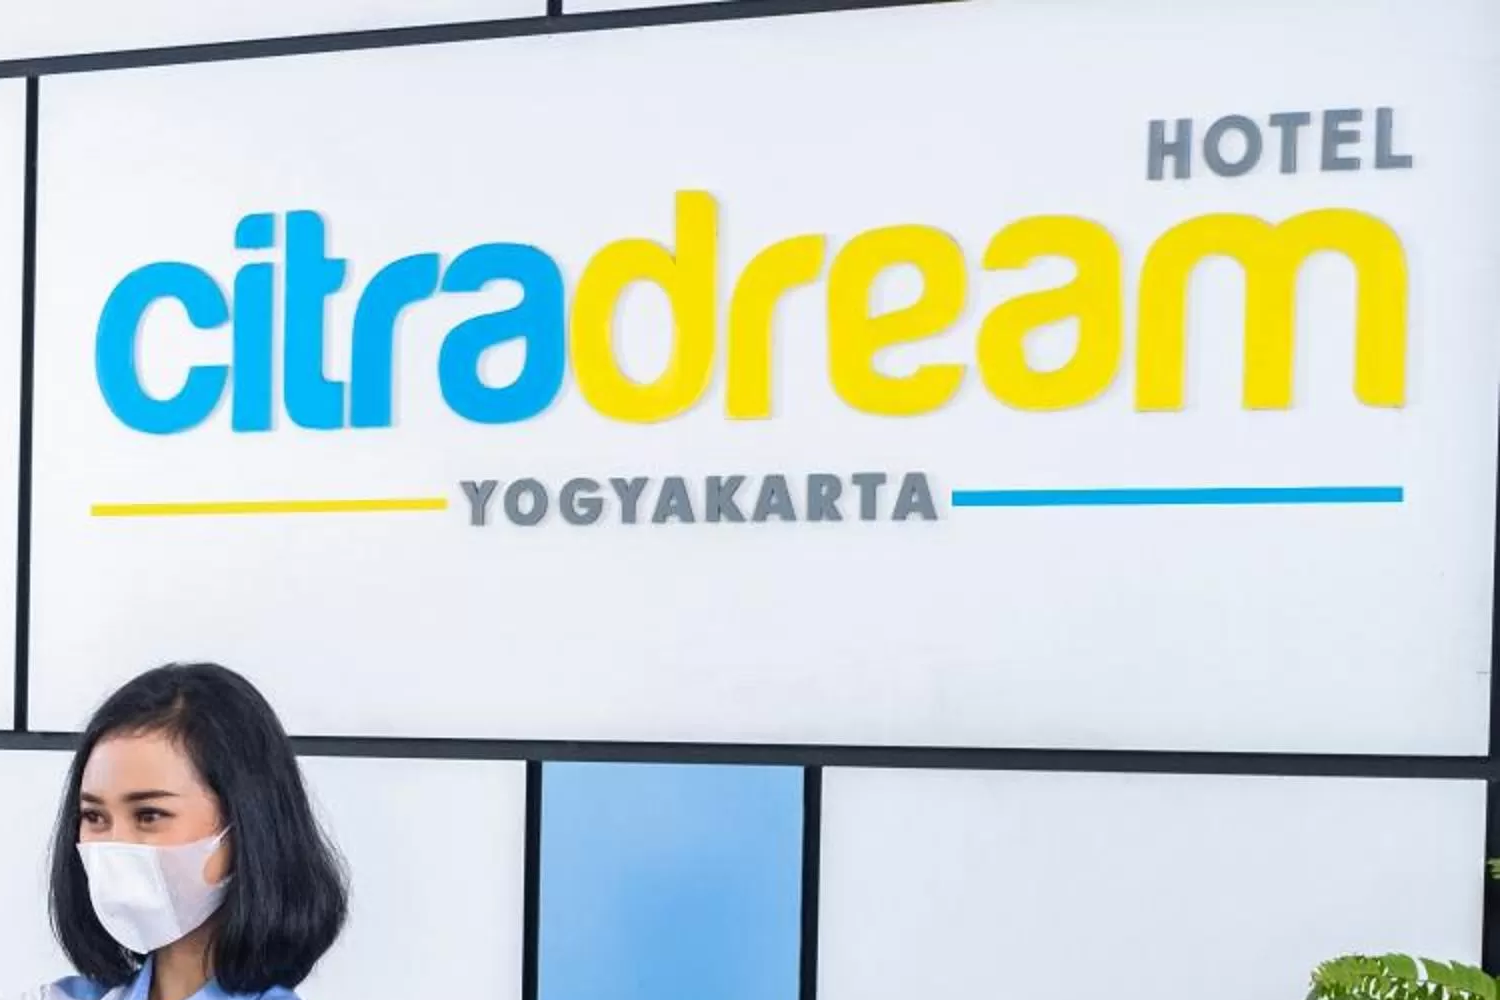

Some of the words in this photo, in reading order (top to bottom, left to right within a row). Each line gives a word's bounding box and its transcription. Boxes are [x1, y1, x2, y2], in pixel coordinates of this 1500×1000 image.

[1147, 107, 1414, 181] HOTEL
[93, 189, 1410, 437] citradream
[458, 471, 939, 528] YOGYAKARTA
